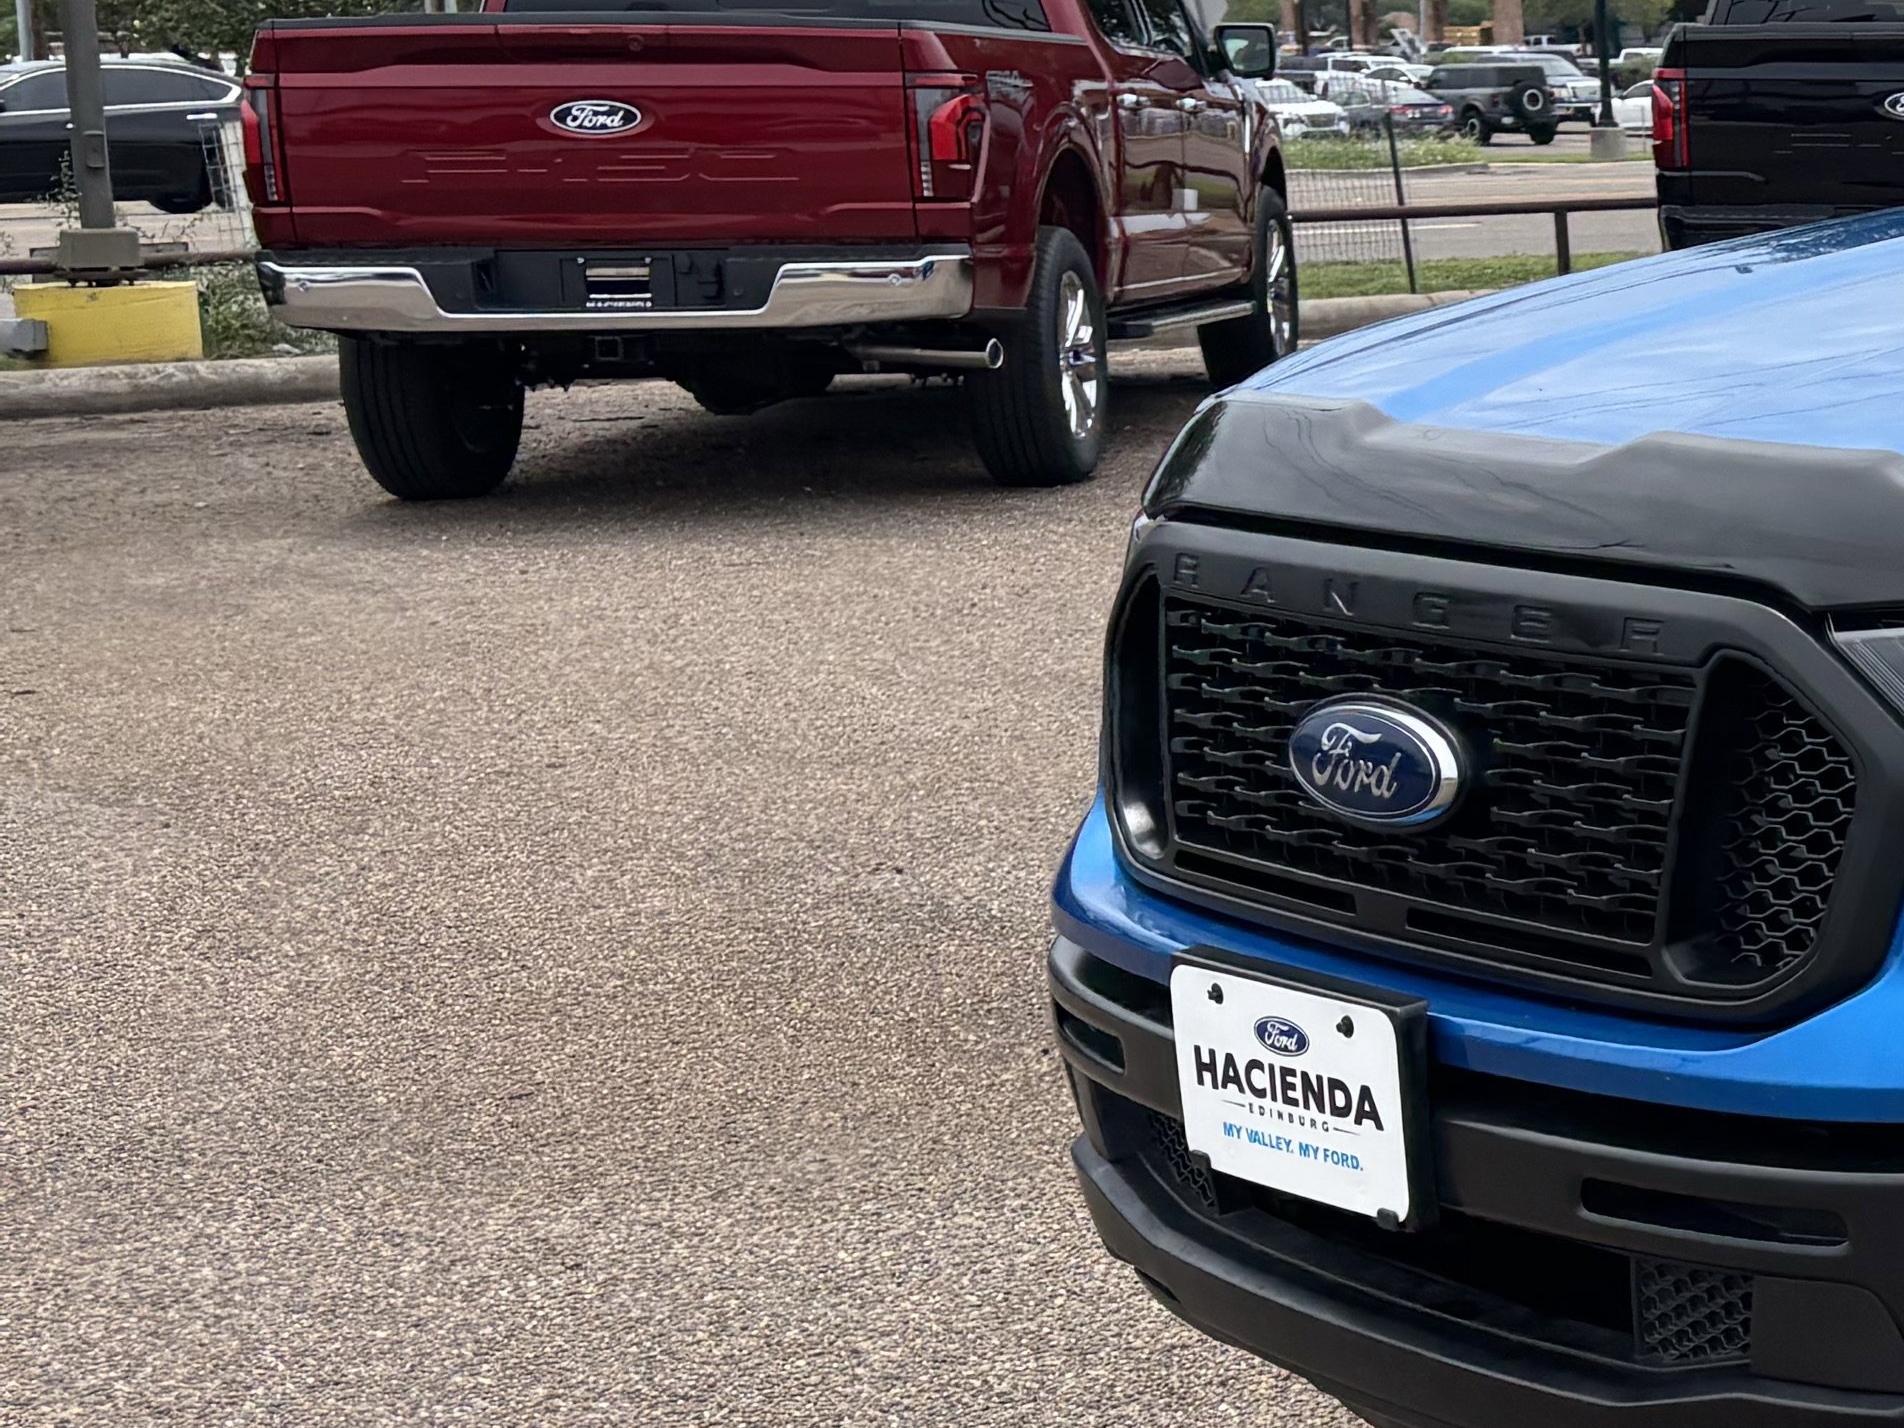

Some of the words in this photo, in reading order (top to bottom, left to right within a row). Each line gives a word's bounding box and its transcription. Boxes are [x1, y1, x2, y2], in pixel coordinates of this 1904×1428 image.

[566, 105, 624, 127] Ford
[1173, 553, 1669, 656] RANGER
[1311, 722, 1401, 801] Ford
[1264, 1022, 1298, 1052] Ford
[1193, 1044, 1384, 1132] HACIENDA
[1248, 1102, 1330, 1133] EDINBURG
[1222, 1122, 1242, 1140] MY
[1245, 1127, 1294, 1154] VALLEY.
[1299, 1141, 1319, 1160] MY
[1323, 1147, 1364, 1172] FORD.
